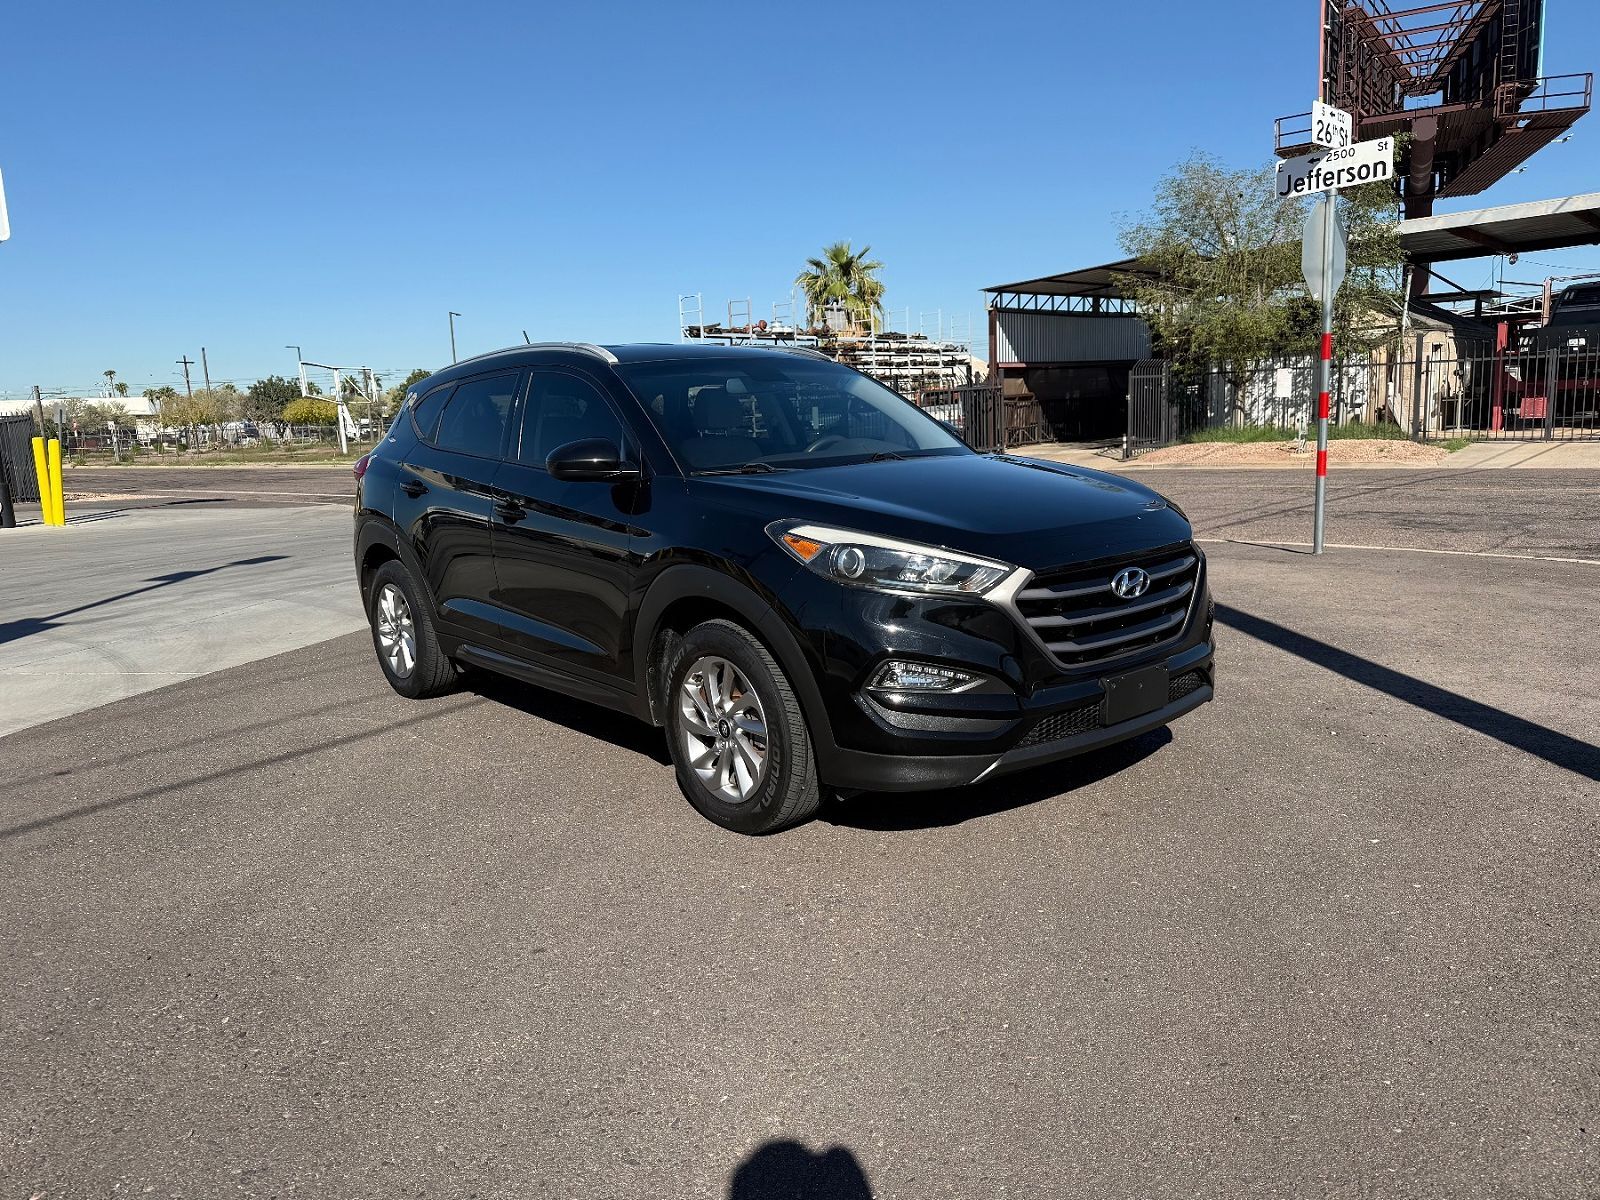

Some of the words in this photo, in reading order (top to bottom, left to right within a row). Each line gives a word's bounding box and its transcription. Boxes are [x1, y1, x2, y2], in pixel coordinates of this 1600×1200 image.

[1339, 126, 1348, 147] St
[1325, 147, 1356, 163] 2500
[1377, 140, 1389, 152] St
[1278, 159, 1387, 197] Jefferson
